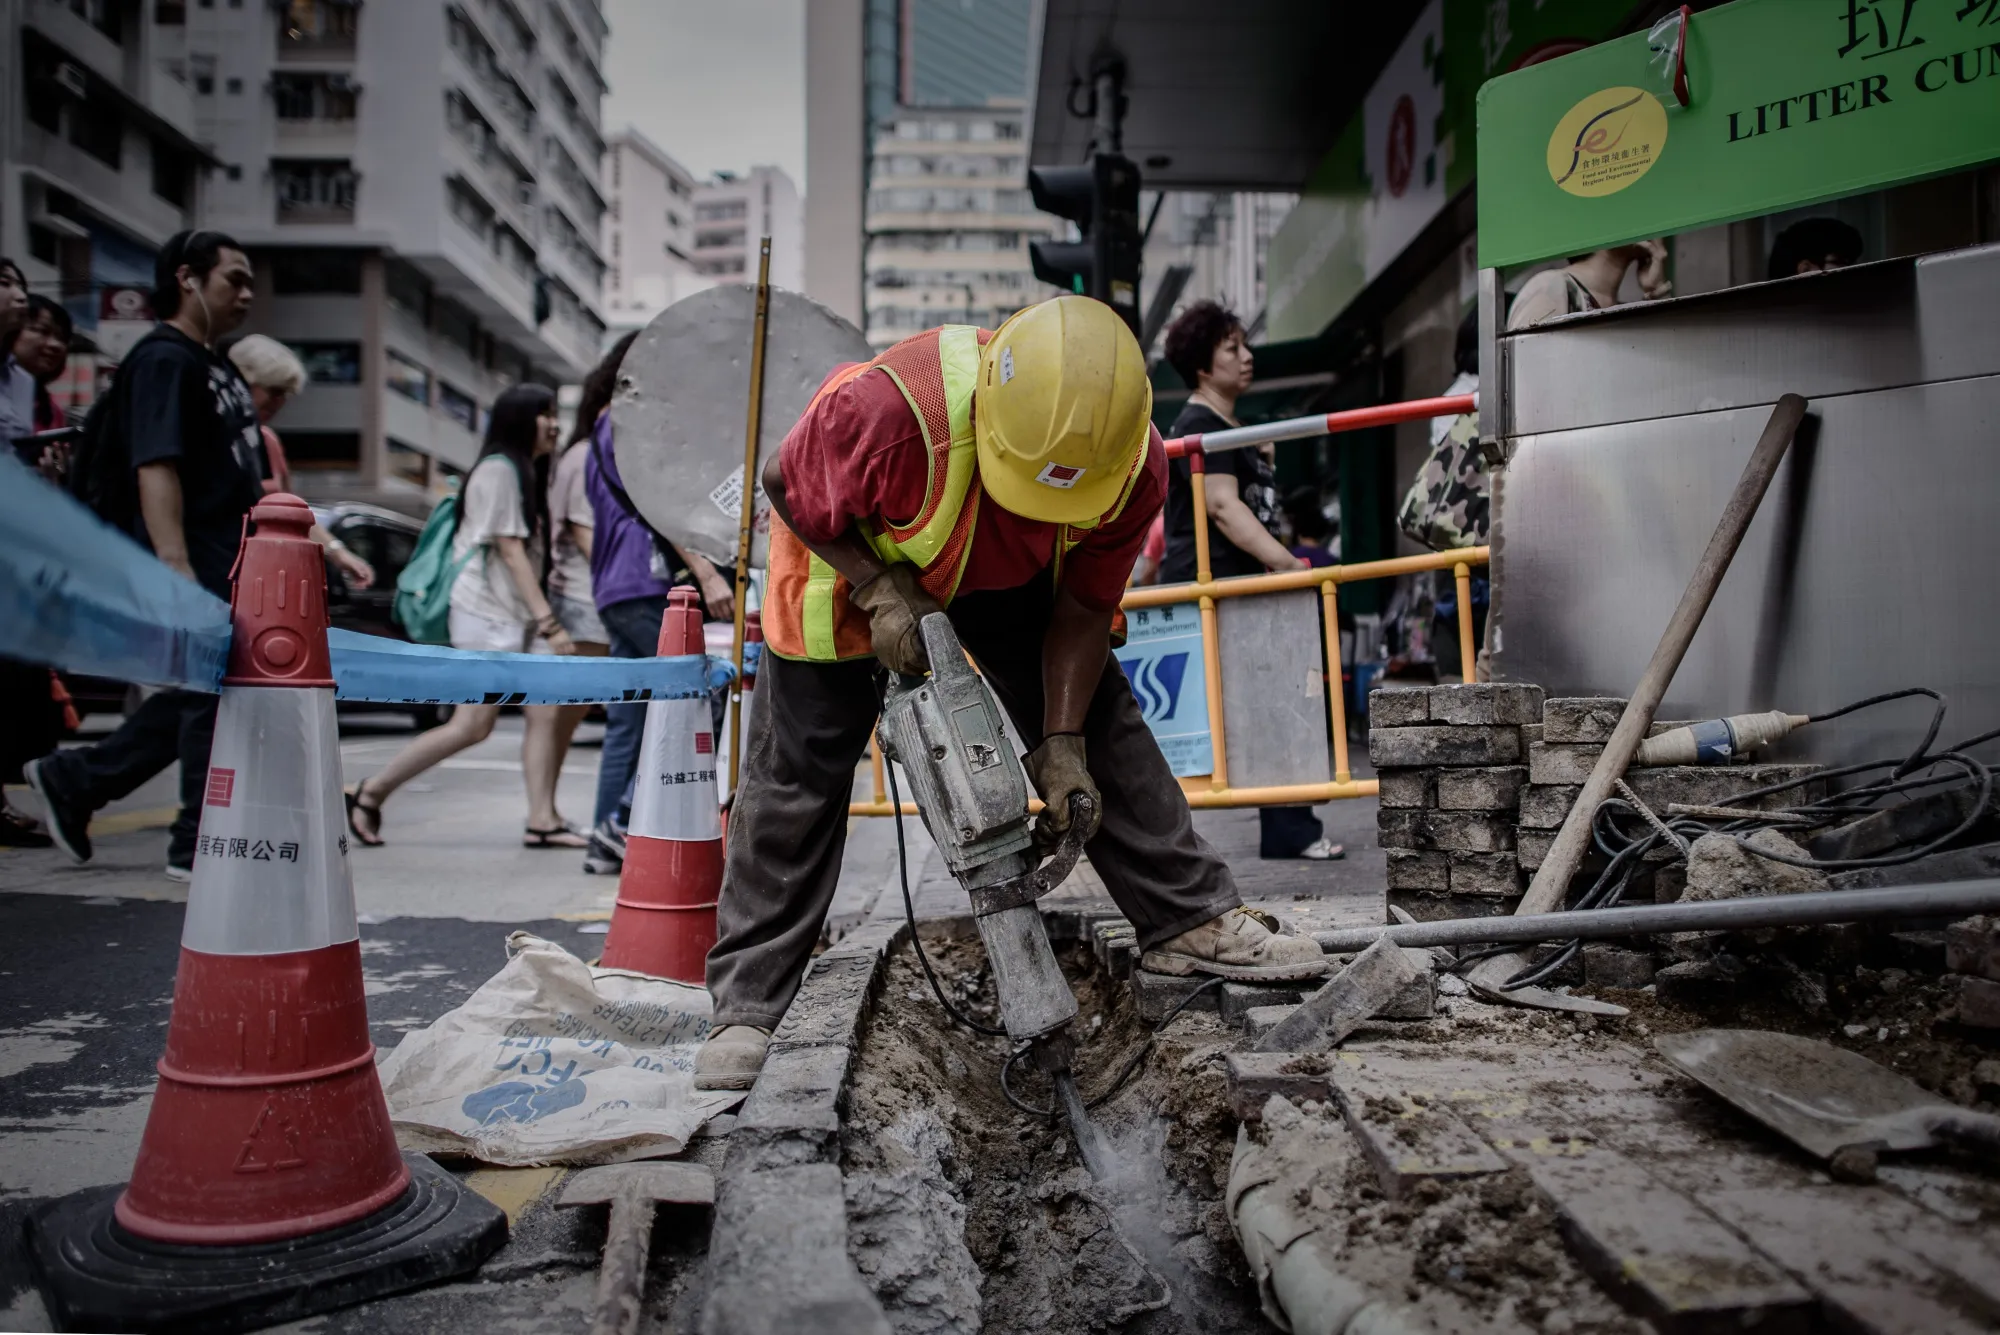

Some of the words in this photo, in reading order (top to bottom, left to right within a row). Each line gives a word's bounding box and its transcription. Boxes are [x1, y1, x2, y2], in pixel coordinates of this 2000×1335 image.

[1727, 74, 1893, 143] LITTER
[1605, 168, 1639, 181] Department
[1152, 622, 1198, 636] Department
[196, 834, 299, 863] 程有限公司
